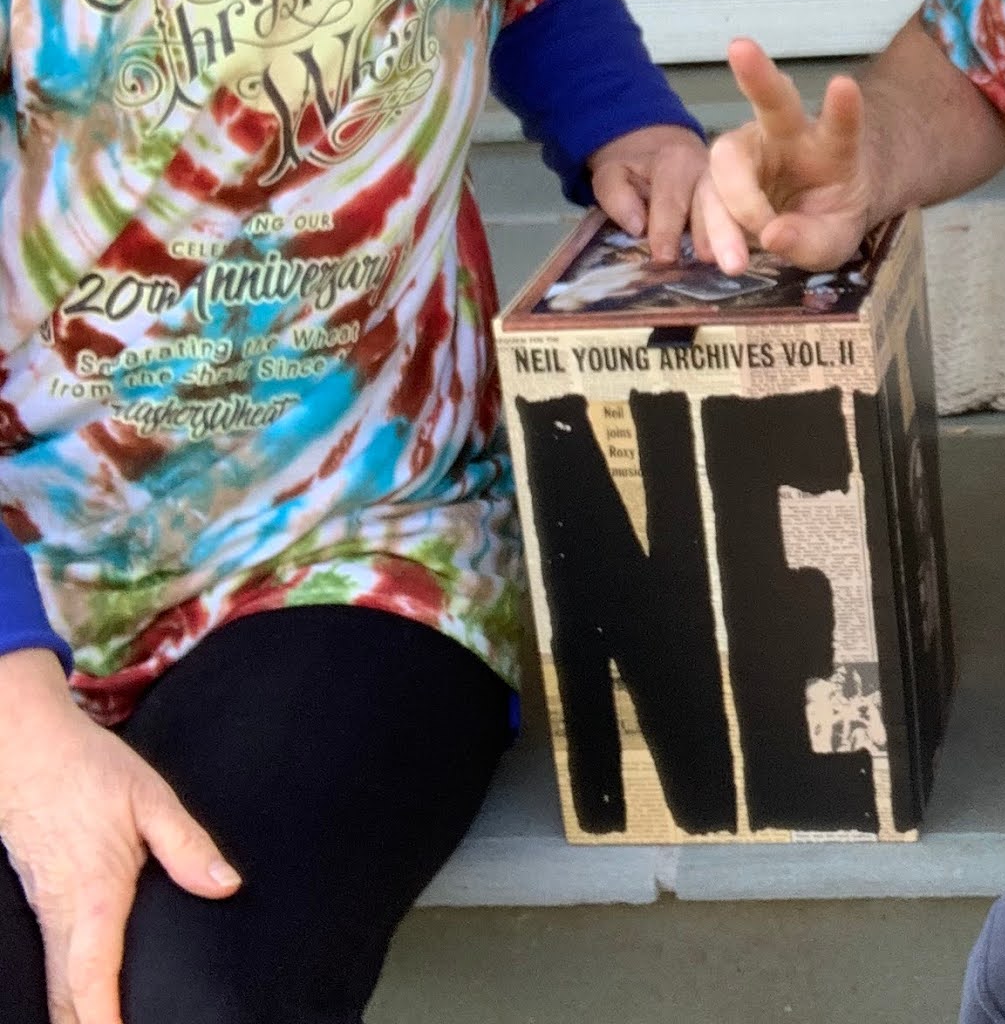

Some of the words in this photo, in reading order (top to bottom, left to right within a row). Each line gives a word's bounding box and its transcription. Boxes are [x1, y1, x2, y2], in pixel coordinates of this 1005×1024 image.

[295, 215, 331, 230] OUR
[80, 339, 230, 374] Searating
[514, 347, 567, 374] NEIL
[572, 346, 650, 373] YOUNG
[660, 342, 775, 370] ARCHIVES
[782, 340, 835, 367] VOL.
[839, 340, 854, 365] II
[50, 378, 113, 398] from
[261, 355, 326, 381] Since
[603, 406, 625, 419] Neil
[606, 426, 633, 440] joins
[608, 445, 635, 460] Roxy
